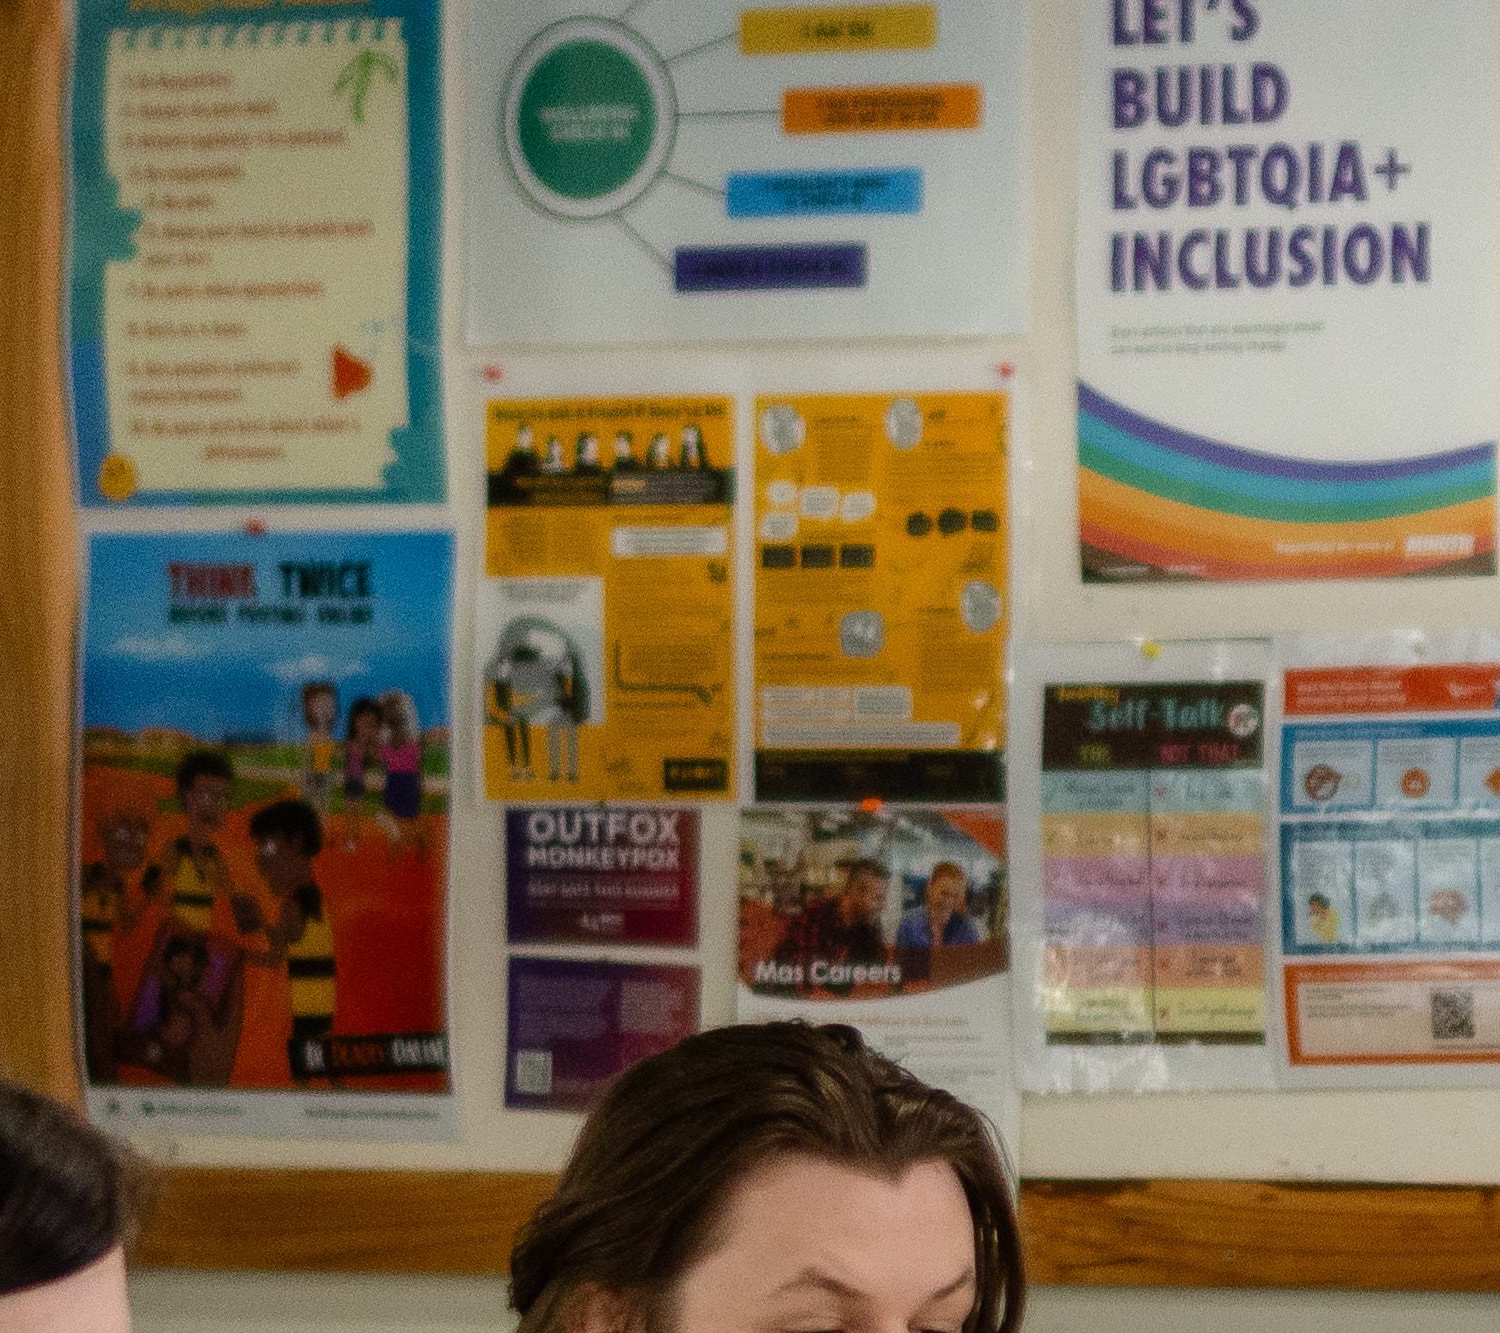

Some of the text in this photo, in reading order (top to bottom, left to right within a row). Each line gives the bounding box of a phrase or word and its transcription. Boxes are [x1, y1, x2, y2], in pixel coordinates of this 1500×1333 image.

[1111, 0, 1257, 46] LET'S
[1112, 62, 1289, 128] BUILD
[1111, 140, 1411, 210] LGBTQIA+
[1109, 221, 1430, 292] INCLUSION
[168, 560, 372, 599] THINK TWICE
[527, 812, 680, 844] OUTFOX
[527, 847, 680, 873] MONKEYPOX
[810, 961, 903, 985] Careers
